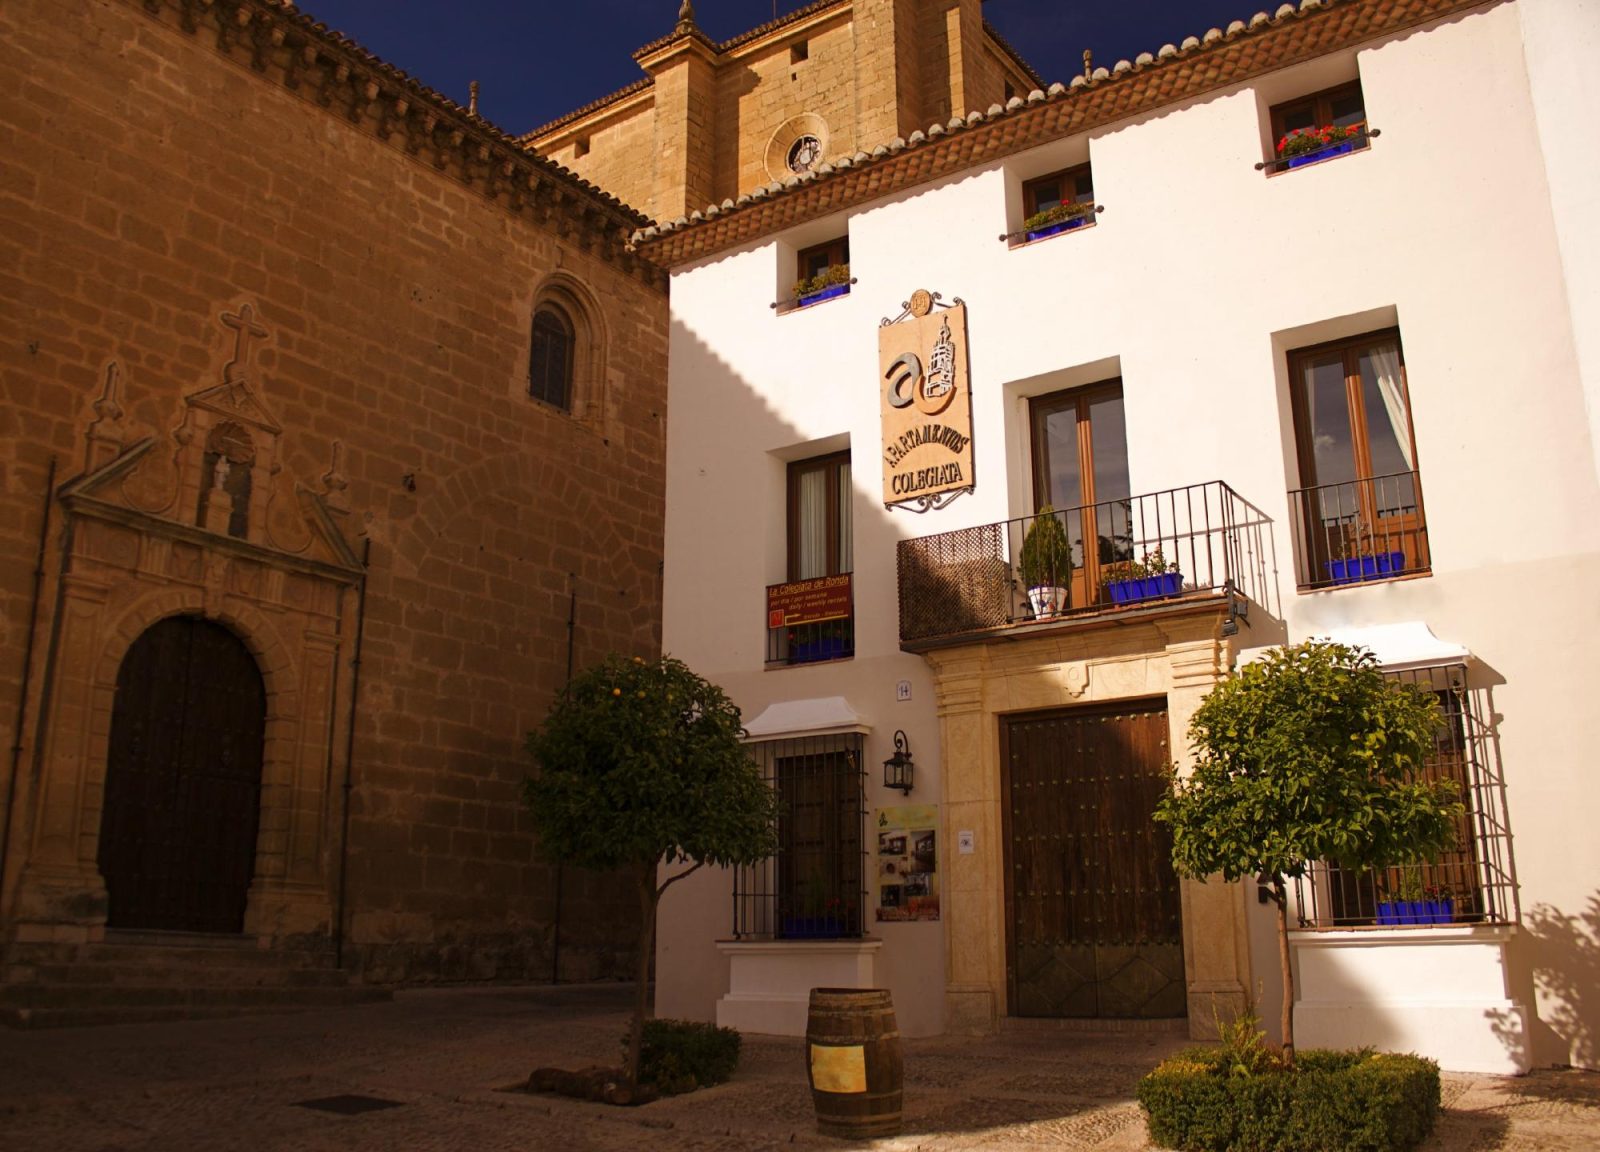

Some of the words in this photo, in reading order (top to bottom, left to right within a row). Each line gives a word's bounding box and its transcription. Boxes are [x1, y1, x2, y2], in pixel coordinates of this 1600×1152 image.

[883, 424, 970, 468] APARTAMENTOS
[892, 461, 963, 495] COLEGIATA
[780, 581, 812, 595] Colegiata
[826, 576, 849, 587] Ronda
